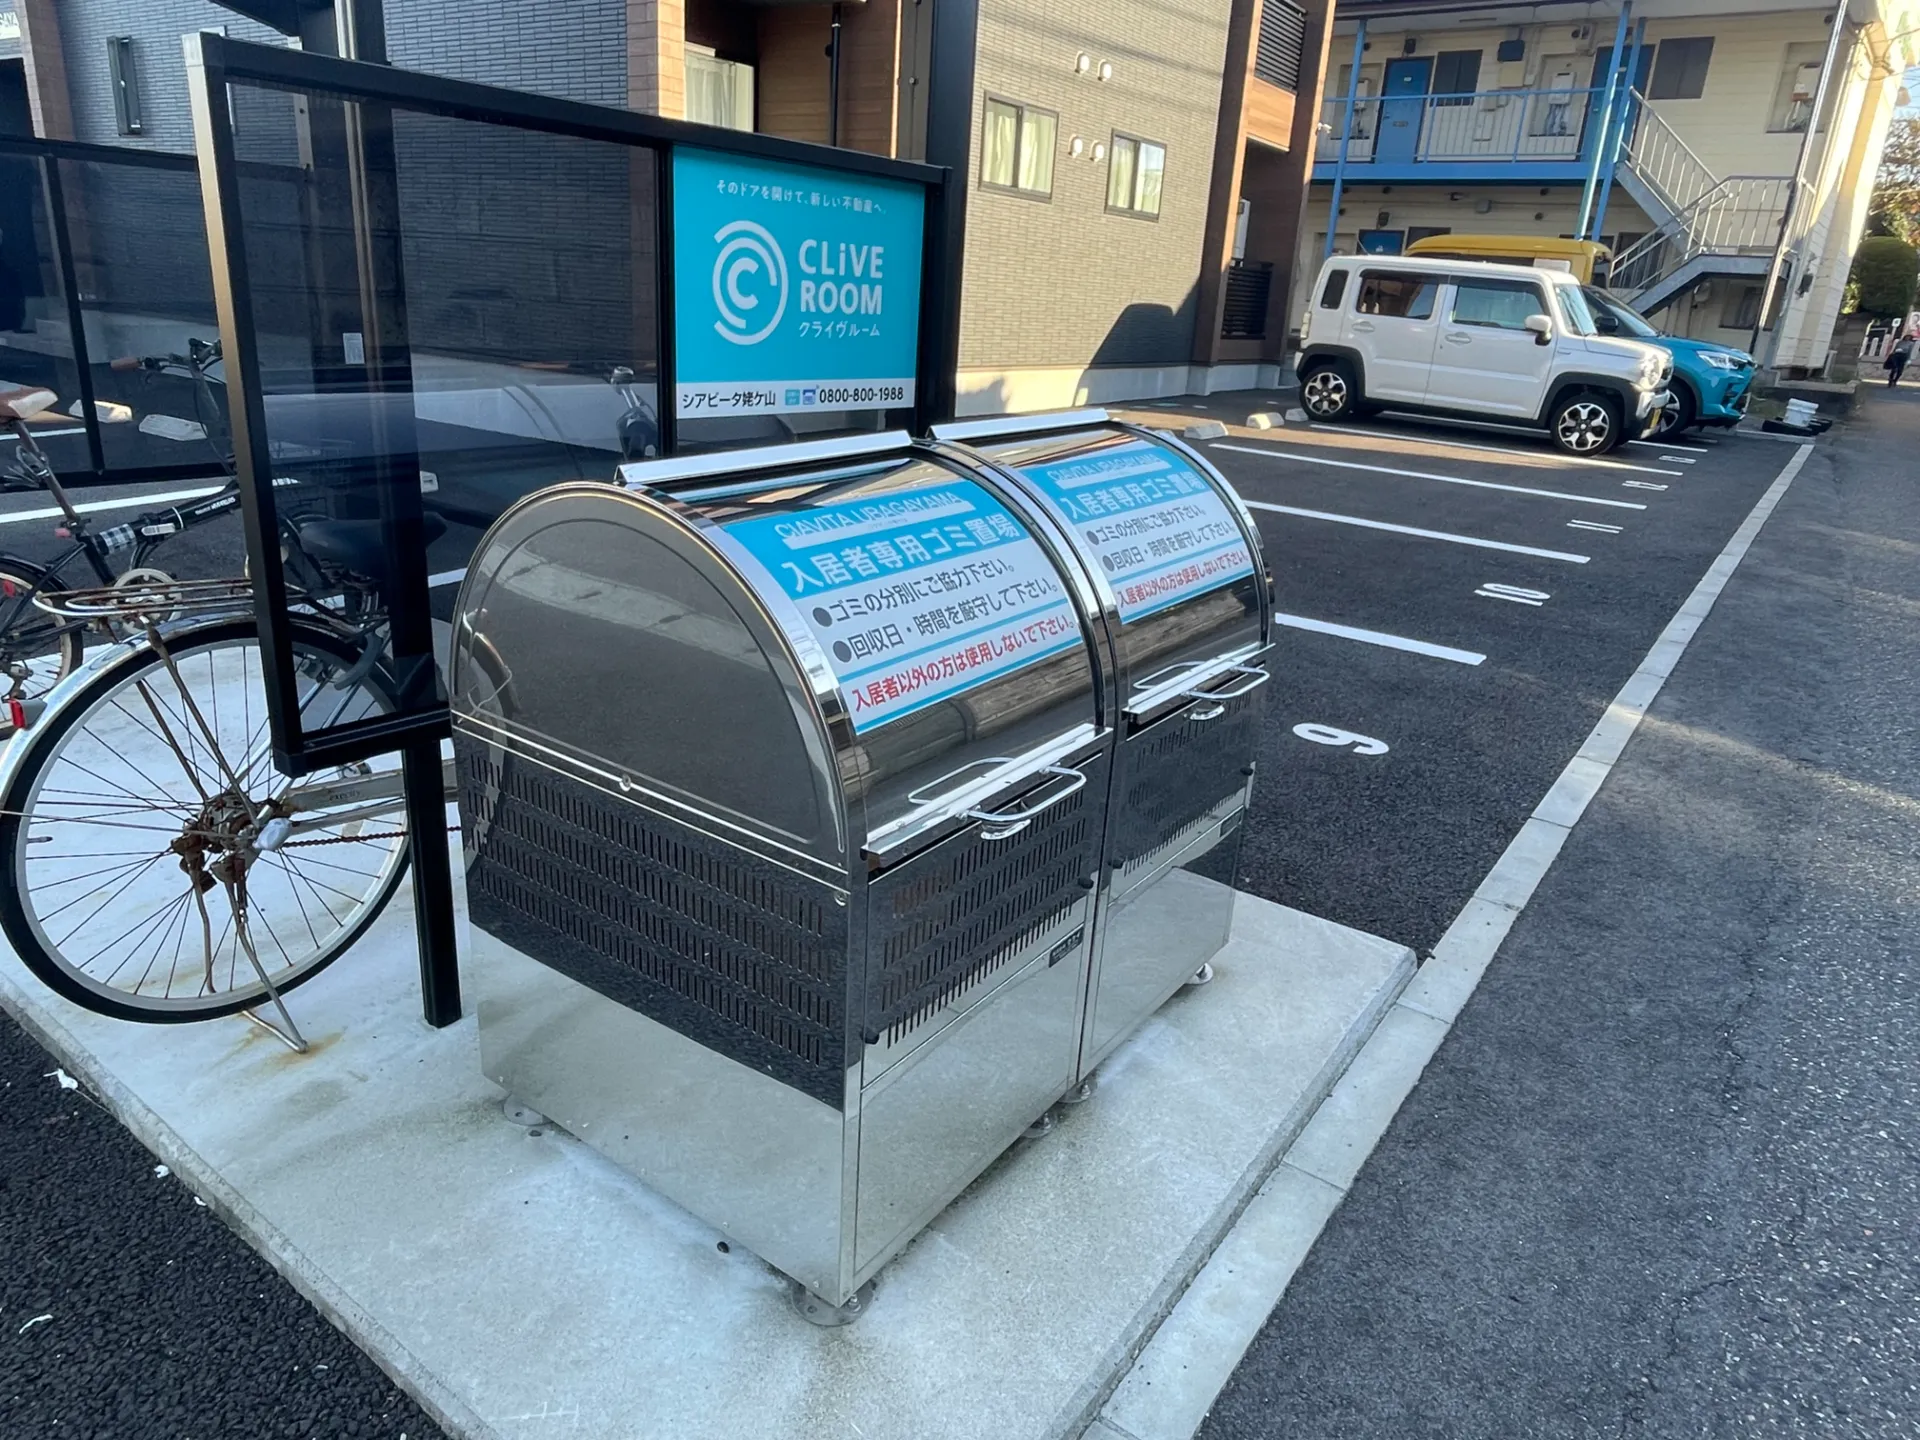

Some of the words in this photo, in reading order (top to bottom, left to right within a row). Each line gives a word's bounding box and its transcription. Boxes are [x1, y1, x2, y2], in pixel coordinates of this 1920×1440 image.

[800, 280, 882, 315] ROOM
[799, 320, 880, 338] クライヴルーム
[819, 386, 904, 403] 0800-800-1988
[774, 512, 856, 538] CIAVITA
[850, 491, 963, 522] UBAGAYAMA
[1060, 471, 1206, 519] 入居者専用ゴミ置場
[781, 513, 1020, 593] 入居者専用ゴミ置場
[851, 613, 1075, 713] 入居者以外の方は使用しないで下さい。
[1293, 722, 1389, 756] 9
